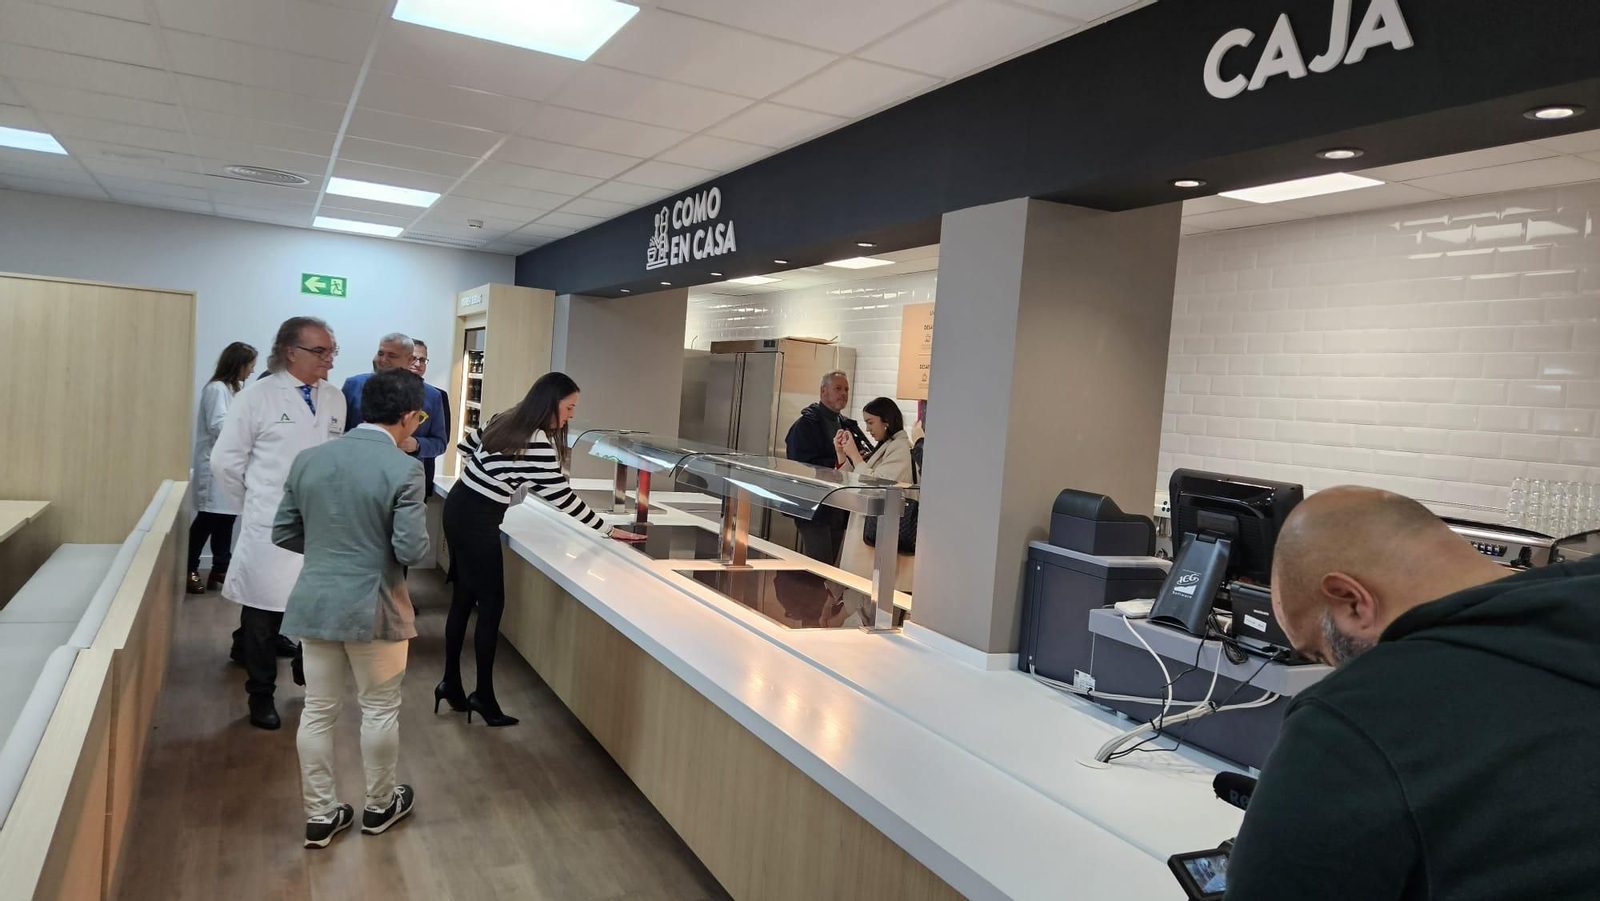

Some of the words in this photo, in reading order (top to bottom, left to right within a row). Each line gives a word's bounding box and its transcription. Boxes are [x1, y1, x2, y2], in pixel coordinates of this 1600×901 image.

[1203, 0, 1414, 99] CAJA
[672, 187, 721, 229] COMO
[670, 233, 691, 265] EN
[693, 220, 736, 260] CASA
[1178, 573, 1199, 584] ICG
